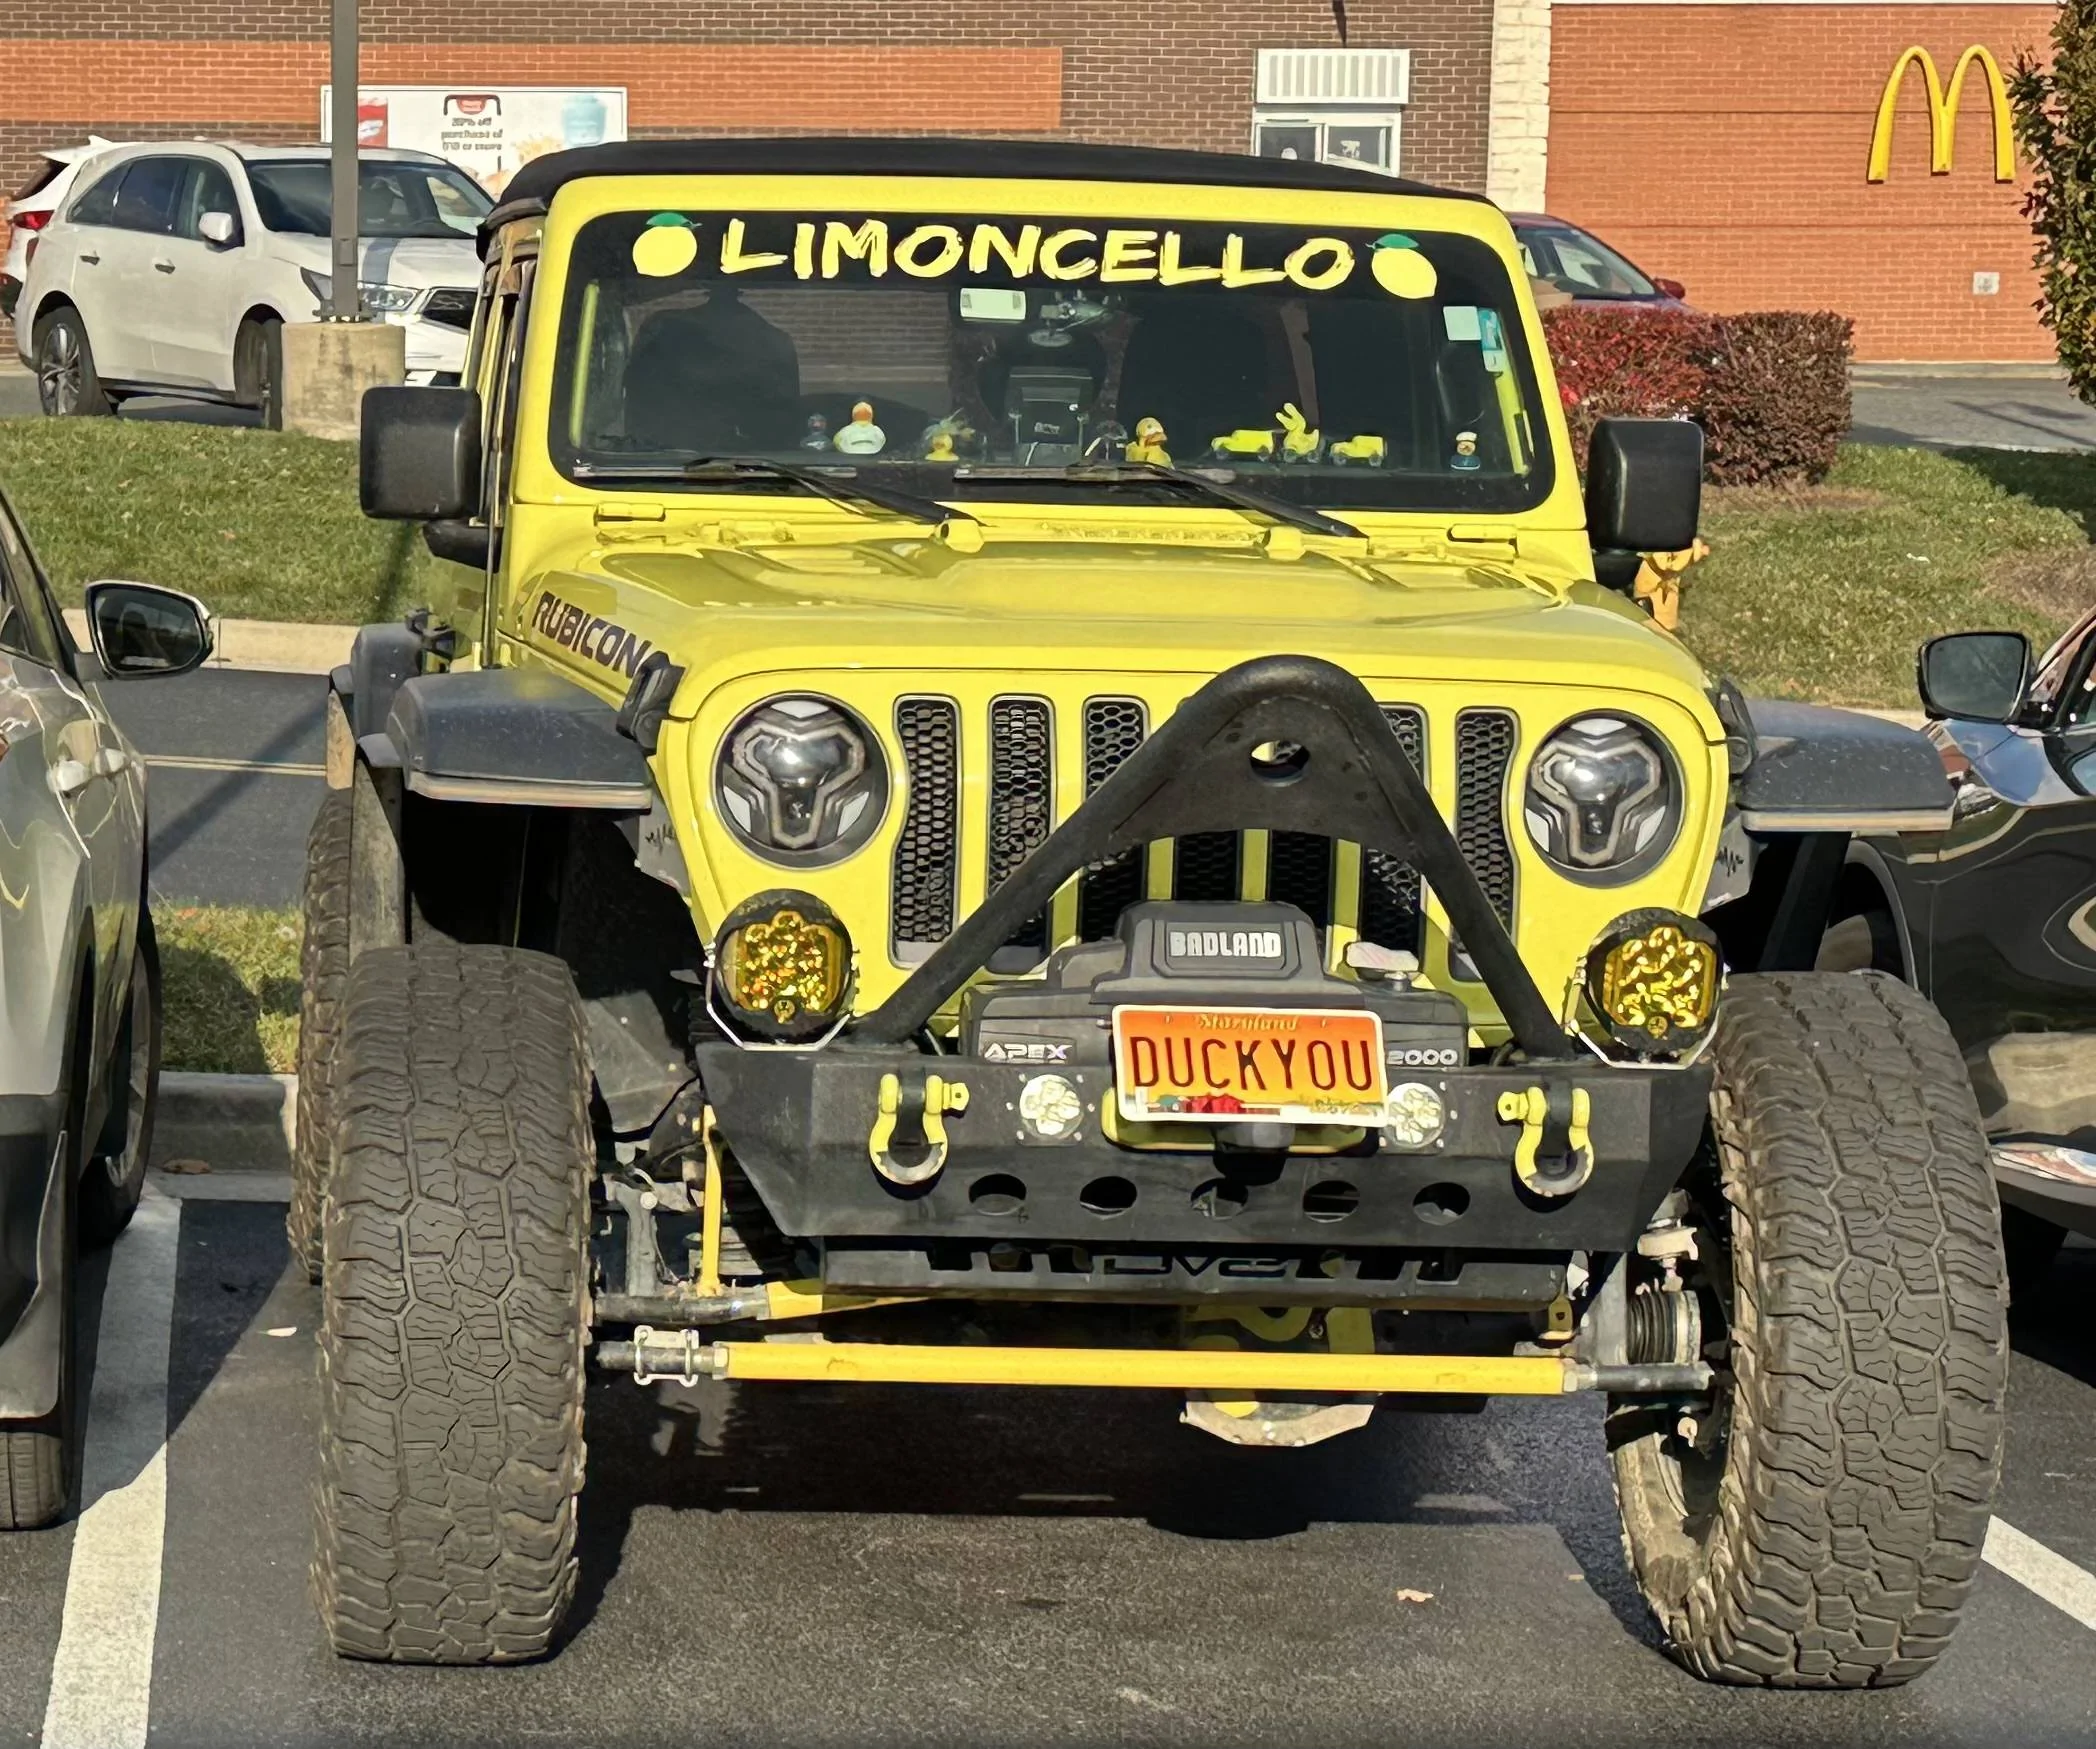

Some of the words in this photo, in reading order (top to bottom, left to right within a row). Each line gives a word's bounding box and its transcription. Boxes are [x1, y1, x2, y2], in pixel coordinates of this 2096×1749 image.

[720, 218, 1356, 291] LIMONCELLO
[532, 590, 653, 679] RUBICON
[1170, 931, 1281, 958] BADLAND
[984, 1042, 1073, 1060] APEX
[1129, 1036, 1374, 1092] DUCKYOU
